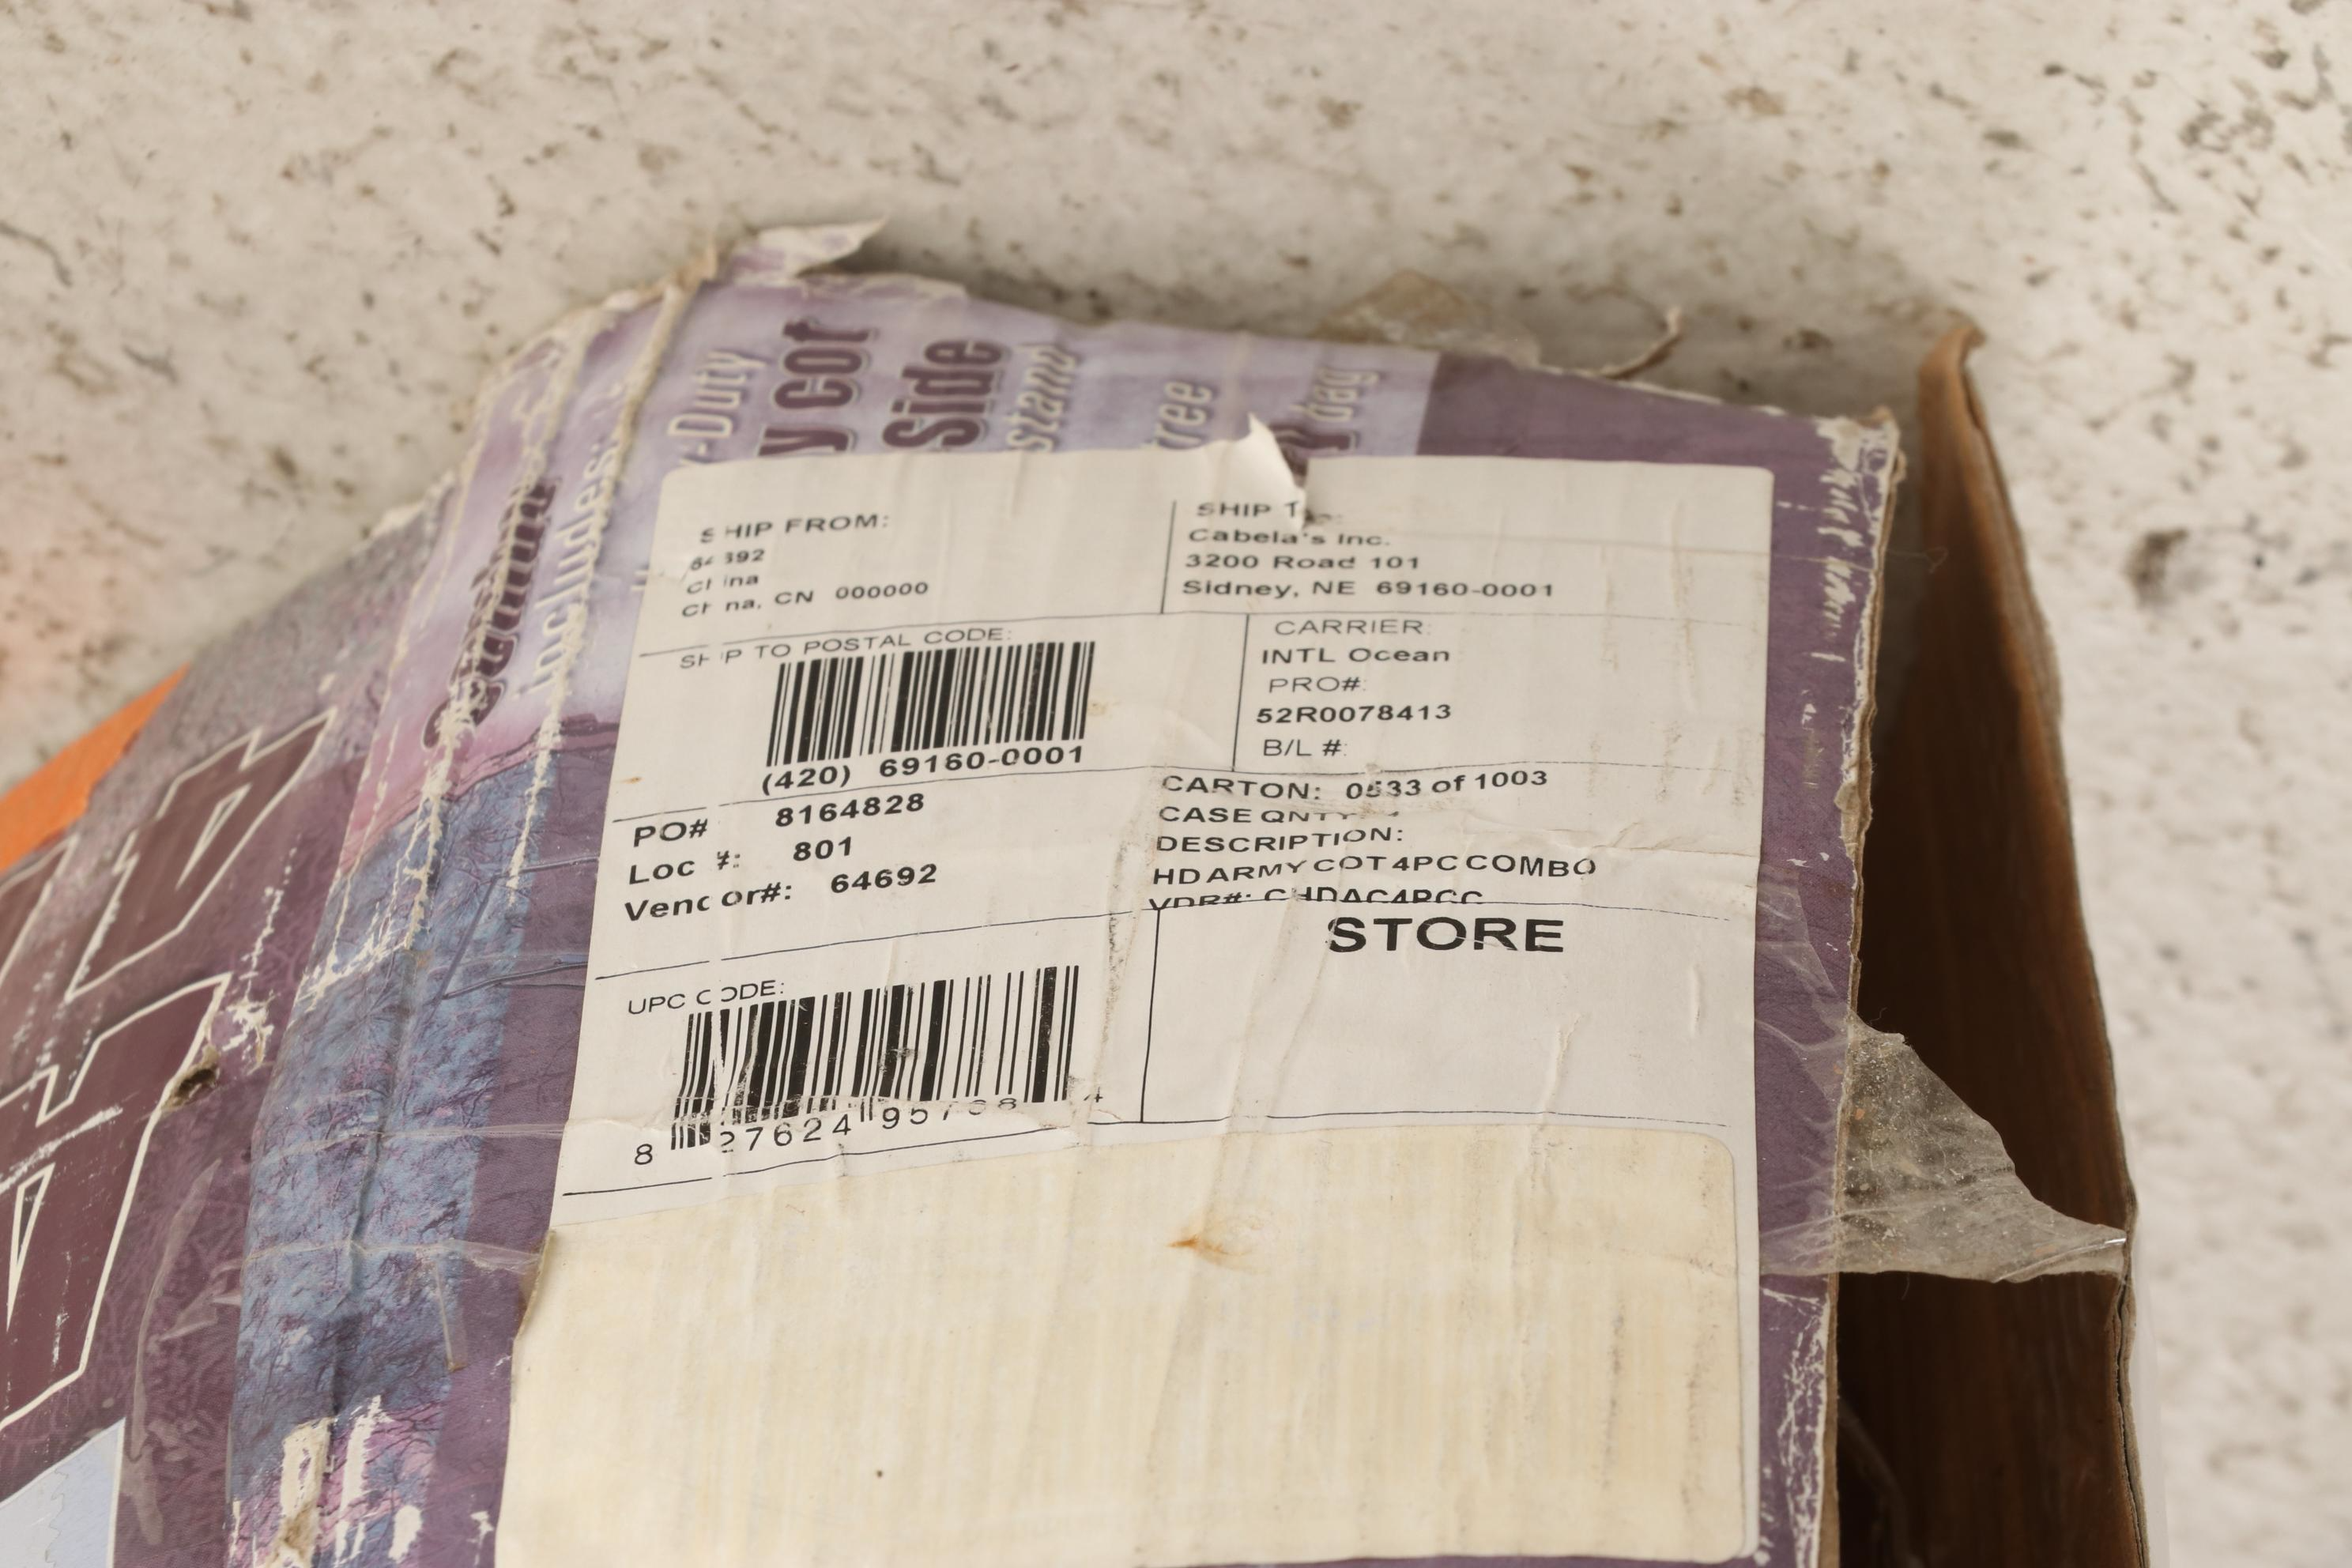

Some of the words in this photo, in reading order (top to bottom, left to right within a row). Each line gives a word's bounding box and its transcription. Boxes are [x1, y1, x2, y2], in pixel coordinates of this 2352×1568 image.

[773, 318, 879, 410] cot
[880, 337, 1005, 450] Side
[1196, 502, 1272, 518] SHIP
[785, 513, 890, 533] FROM:
[1188, 527, 1326, 545] Cabela's
[1337, 533, 1391, 546] Inc.
[1185, 553, 1259, 569] 3200
[1272, 555, 1356, 570] Road
[1370, 556, 1420, 570] 101
[774, 590, 815, 605] CN
[835, 582, 929, 600] 000000
[1182, 579, 1299, 598] Sidney,
[1313, 581, 1356, 596] NE
[1376, 581, 1554, 597] 69160-0001
[754, 643, 791, 660] TO
[803, 632, 912, 655] POSTAL
[924, 628, 1013, 645] CODE:
[1261, 647, 1336, 665] INTL
[1348, 646, 1450, 663] Ocean
[1256, 703, 1453, 724] 52R0078413
[1263, 738, 1312, 757] B/L
[761, 765, 852, 795] (420)
[879, 745, 1084, 778] 69160-0001
[1161, 775, 1321, 800] CARTON:
[1431, 774, 1466, 793] of
[1474, 770, 1548, 790] 1003
[633, 819, 709, 847] PO#
[775, 793, 925, 827] 8164828
[1159, 805, 1252, 824] CASE
[1156, 827, 1404, 853] DESCRIPTION:
[629, 860, 695, 885] Loc
[793, 836, 853, 861] 801
[1205, 859, 1308, 883] ARMY
[1313, 855, 1387, 872] COT
[1465, 854, 1596, 877] COMBO
[830, 863, 938, 894] 64692
[1328, 915, 1566, 953] STORE
[628, 993, 686, 1015] UPC
[634, 1143, 654, 1166] 8
